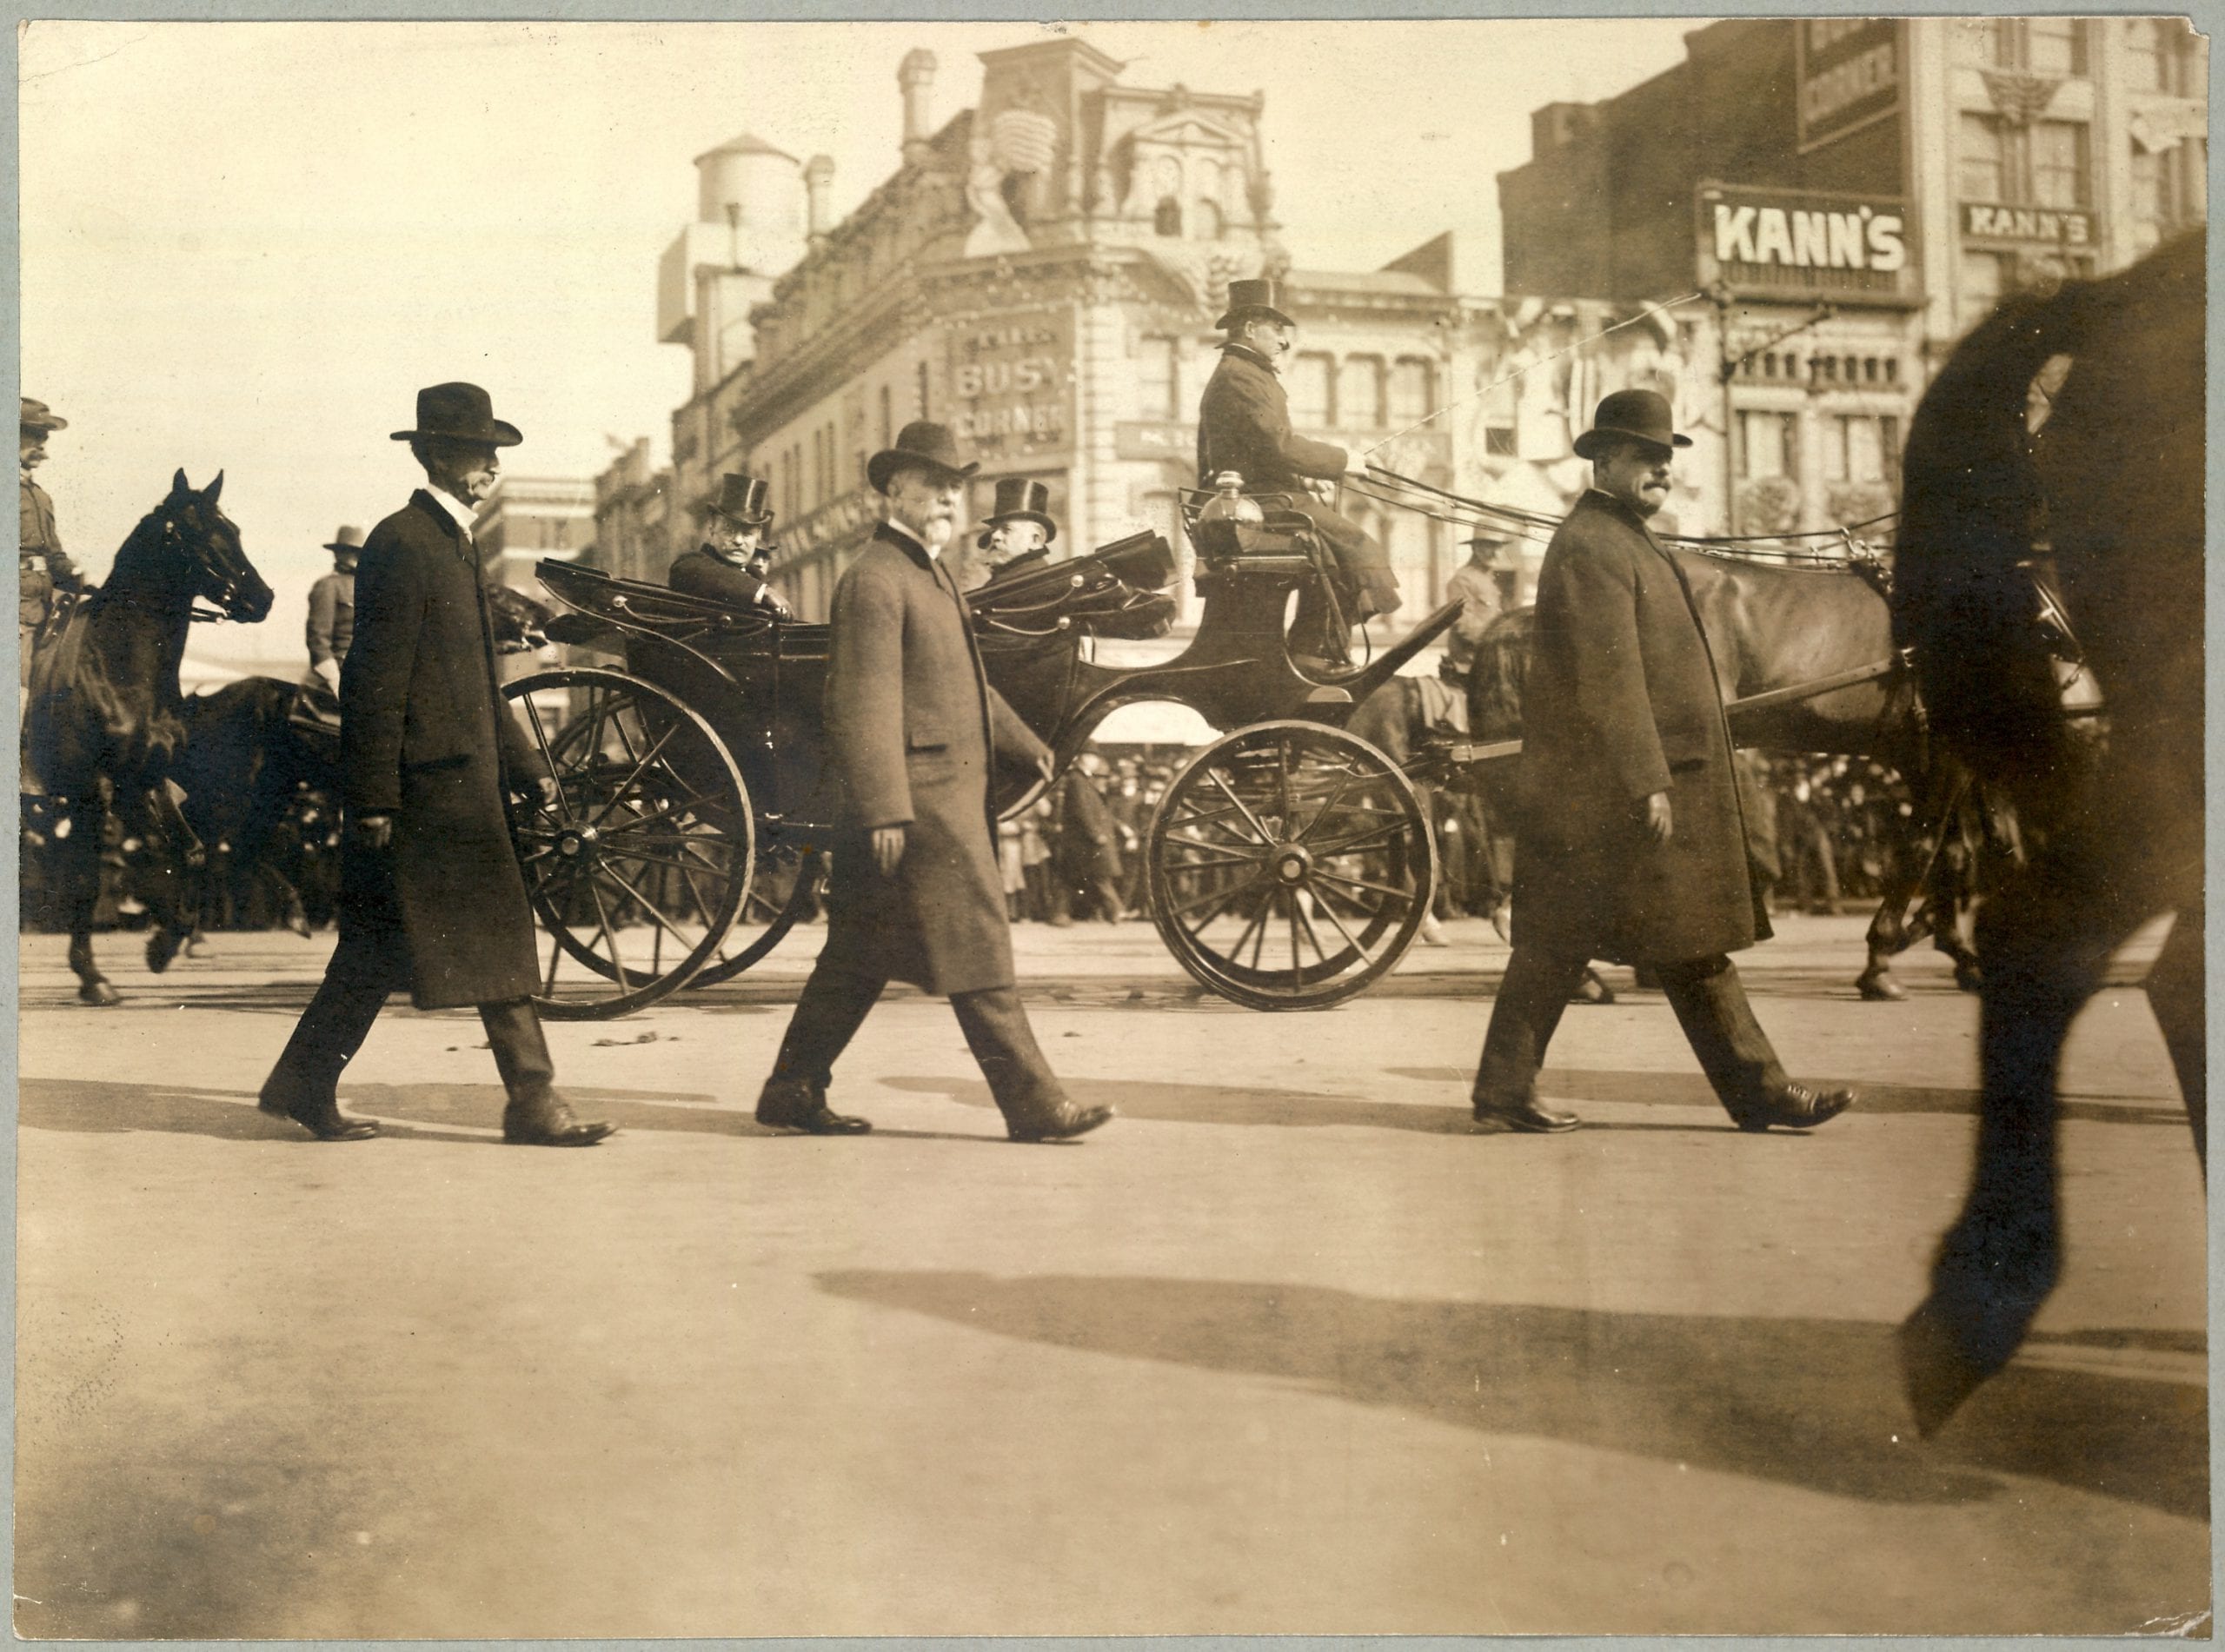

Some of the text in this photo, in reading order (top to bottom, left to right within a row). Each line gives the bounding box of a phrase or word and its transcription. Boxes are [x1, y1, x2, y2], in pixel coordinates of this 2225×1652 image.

[1715, 204, 1905, 271] KANN'S
[1970, 206, 2088, 242] KANN'S
[957, 357, 1064, 397] BUSY
